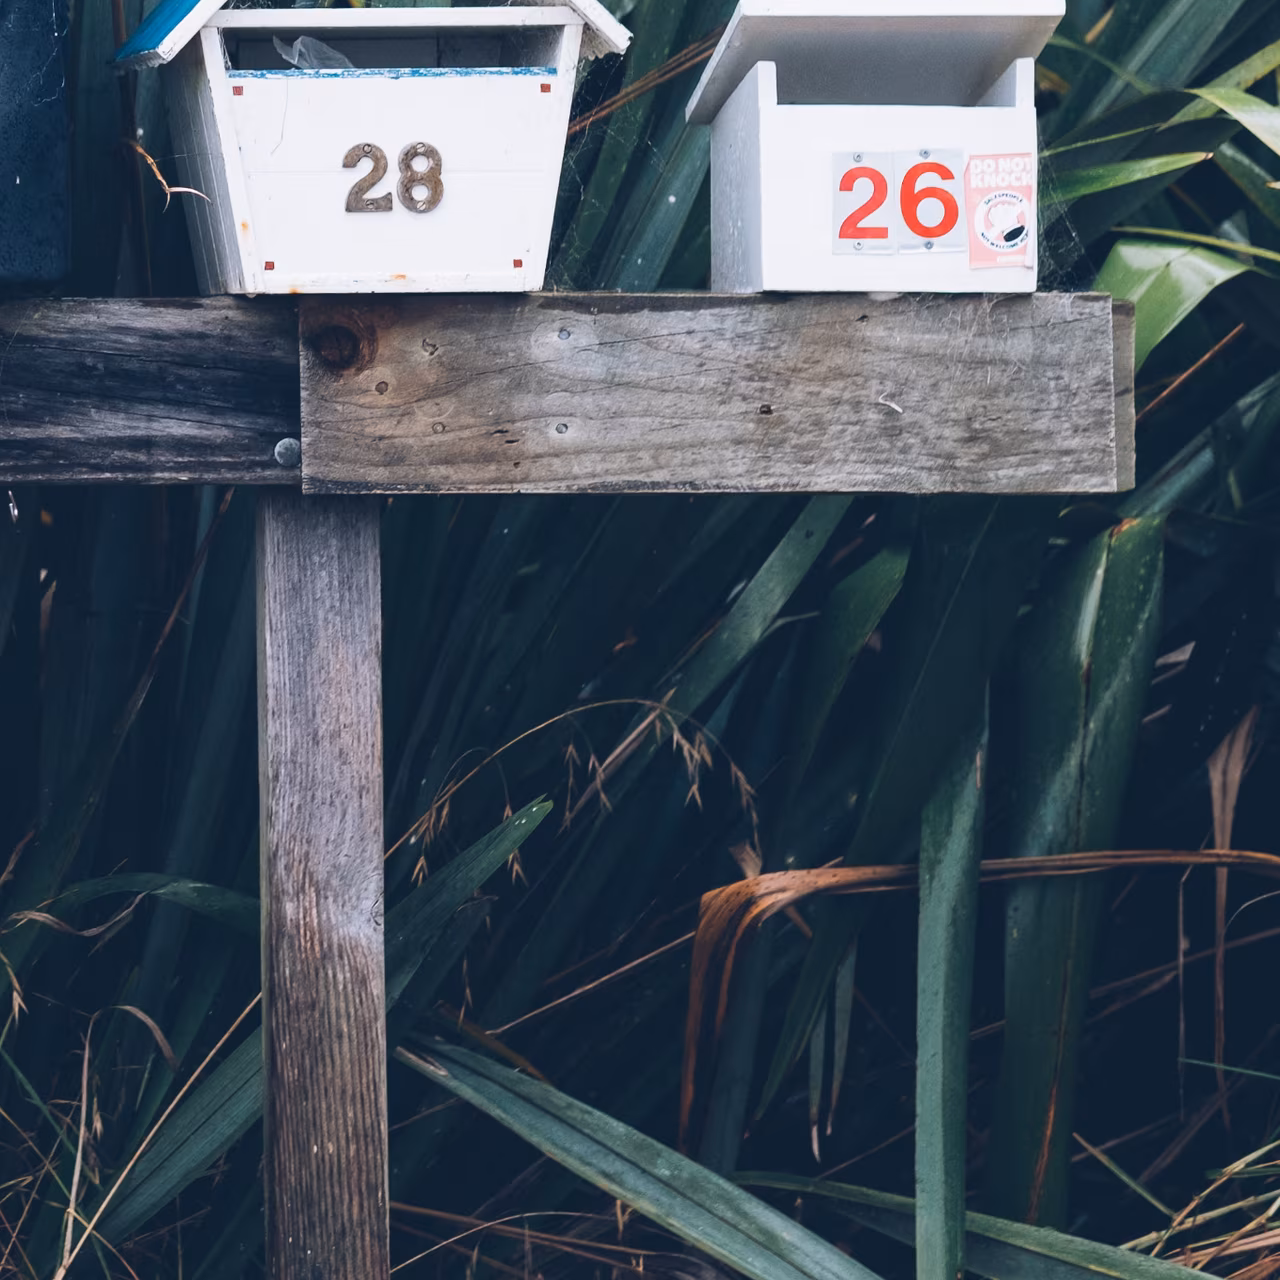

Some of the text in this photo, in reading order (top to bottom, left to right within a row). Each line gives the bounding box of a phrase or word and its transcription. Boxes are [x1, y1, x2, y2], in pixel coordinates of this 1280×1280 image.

[342, 141, 445, 214] 28
[970, 157, 1033, 174] DO NOT
[970, 172, 1033, 188] KNOCK
[838, 161, 959, 240] 26
